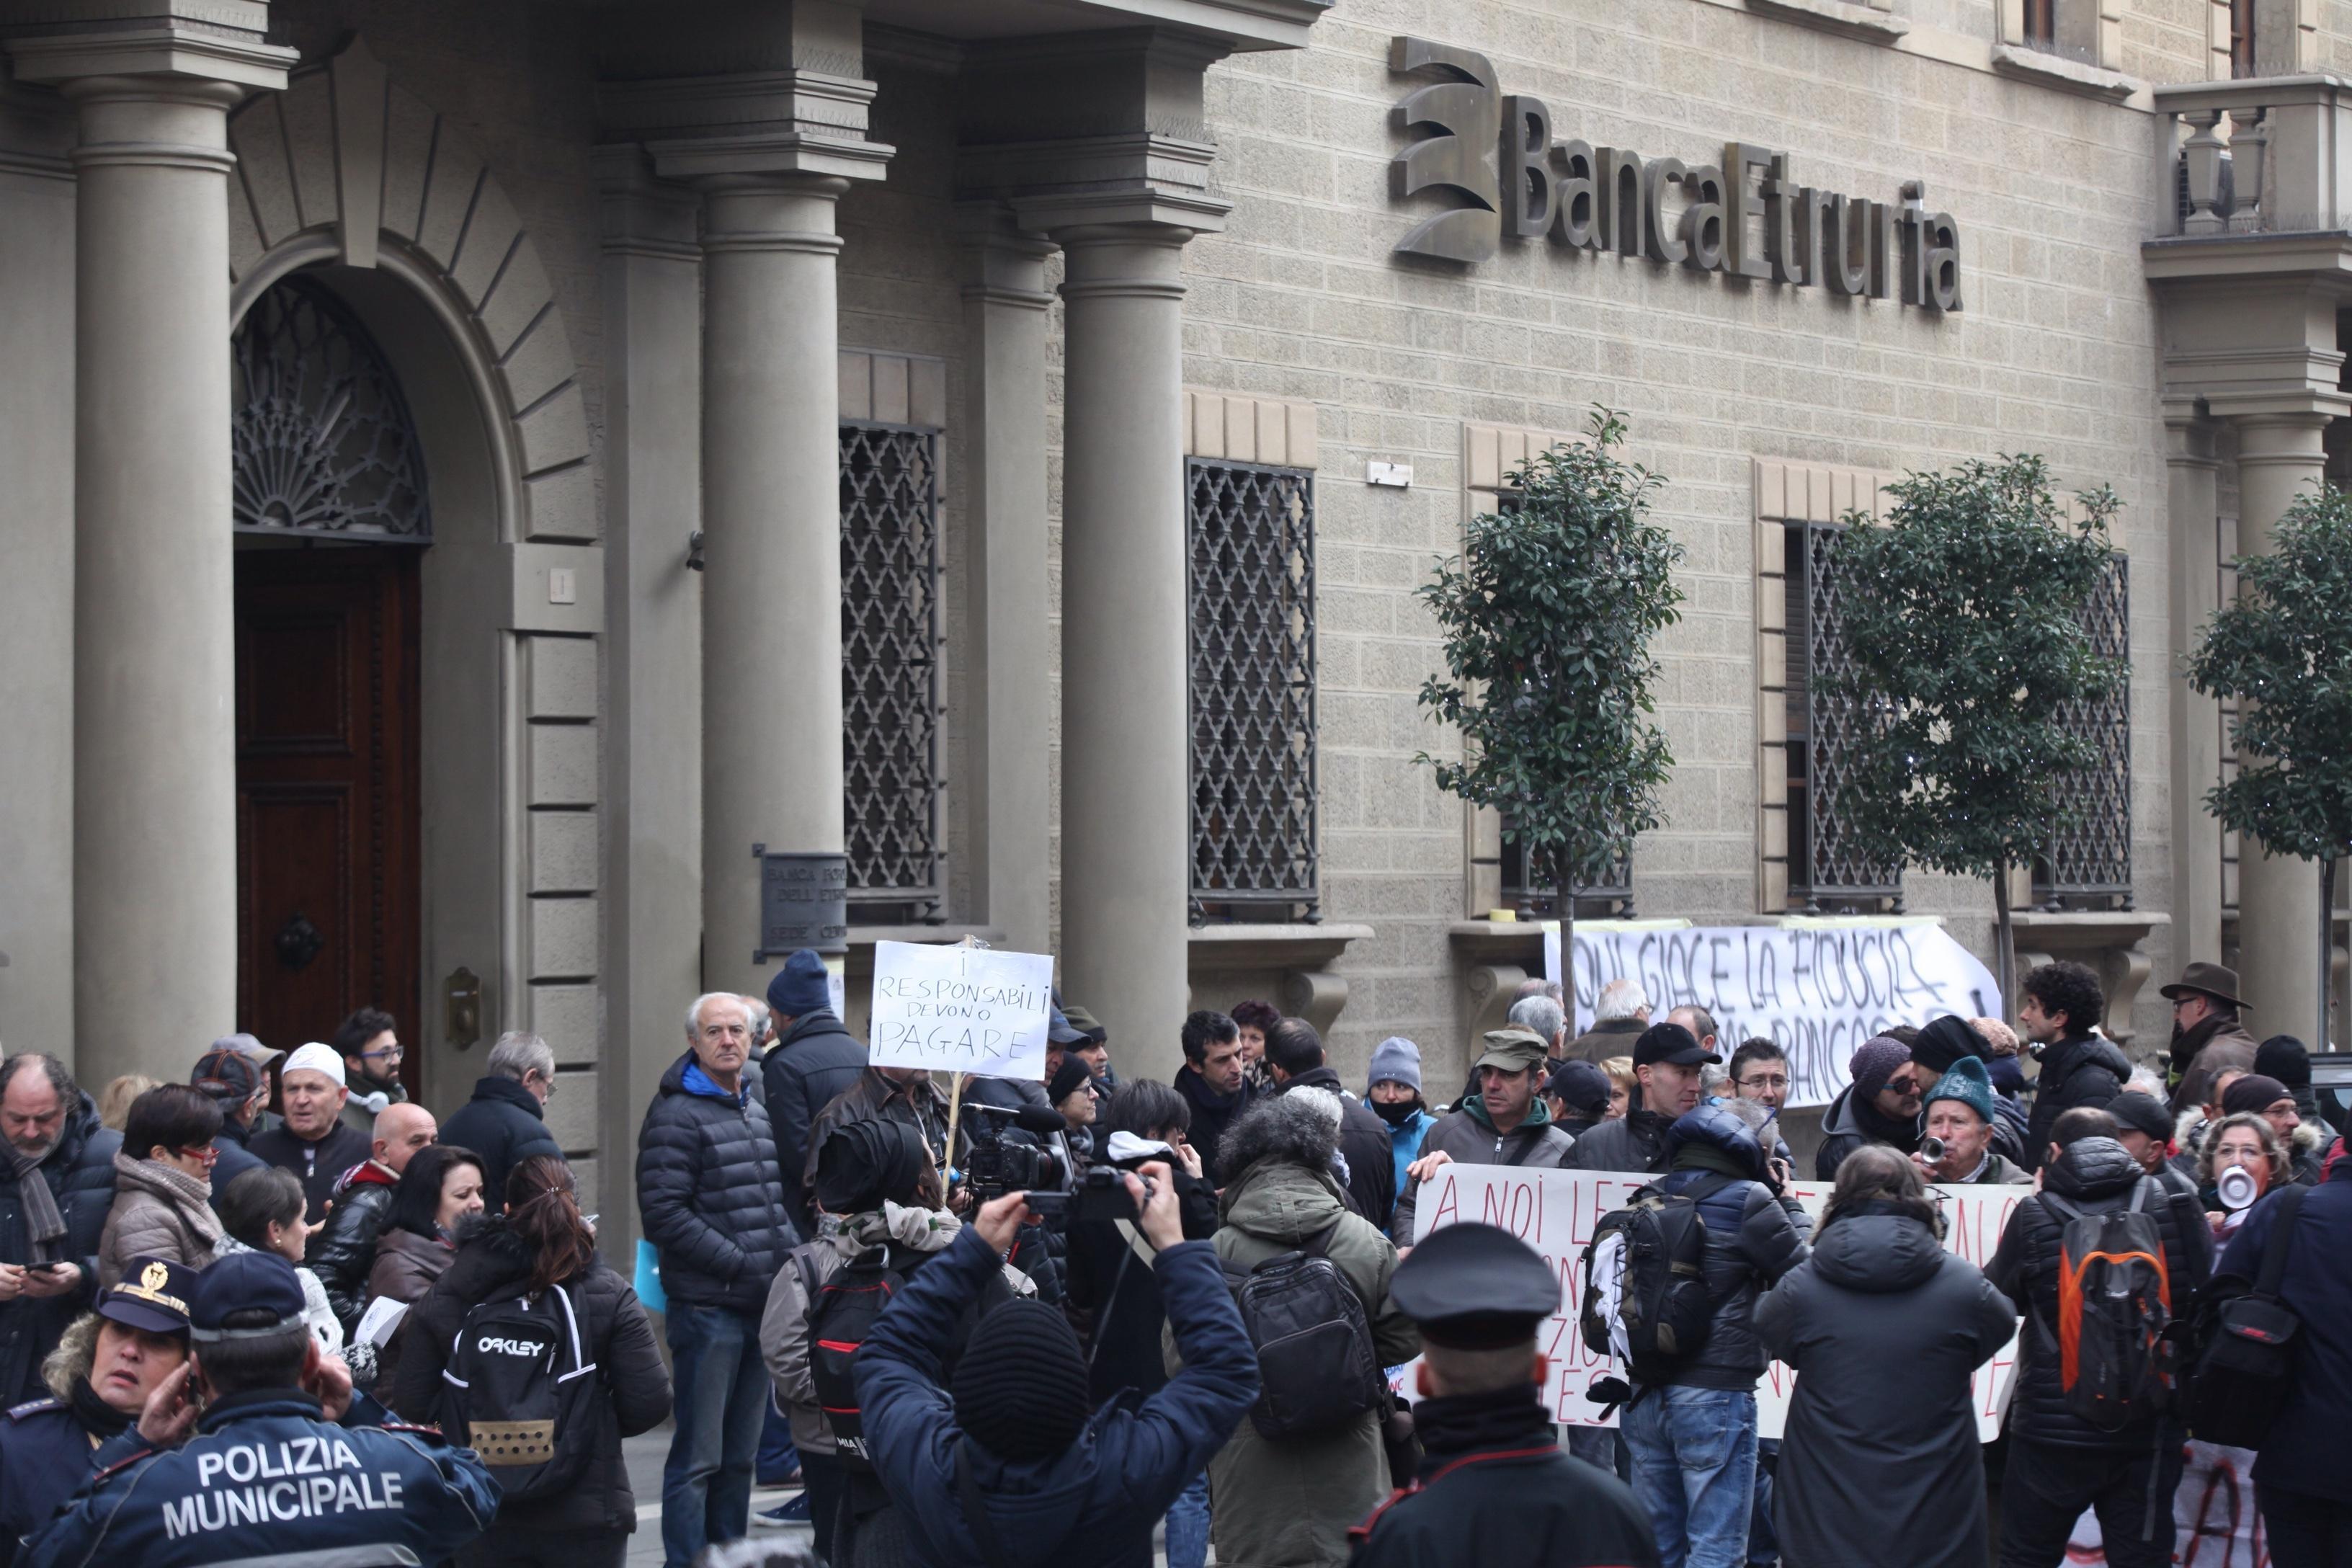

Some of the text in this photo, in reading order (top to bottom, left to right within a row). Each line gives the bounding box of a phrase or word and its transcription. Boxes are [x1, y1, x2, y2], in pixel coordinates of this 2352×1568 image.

[1501, 95, 1964, 312] BancaEtruria
[767, 868, 816, 881] BANCA
[770, 926, 808, 939] SEDE
[1572, 927, 1949, 1015] QUI GIACE LA FIDUCIA
[907, 1002, 992, 1021] DEVONO
[877, 1021, 1028, 1059] PAGARE
[1430, 1175, 1458, 1234] A
[478, 1337, 545, 1357] OAKLEY
[197, 1437, 362, 1487] POLIZIA
[161, 1471, 404, 1541] MUNICIPALE
